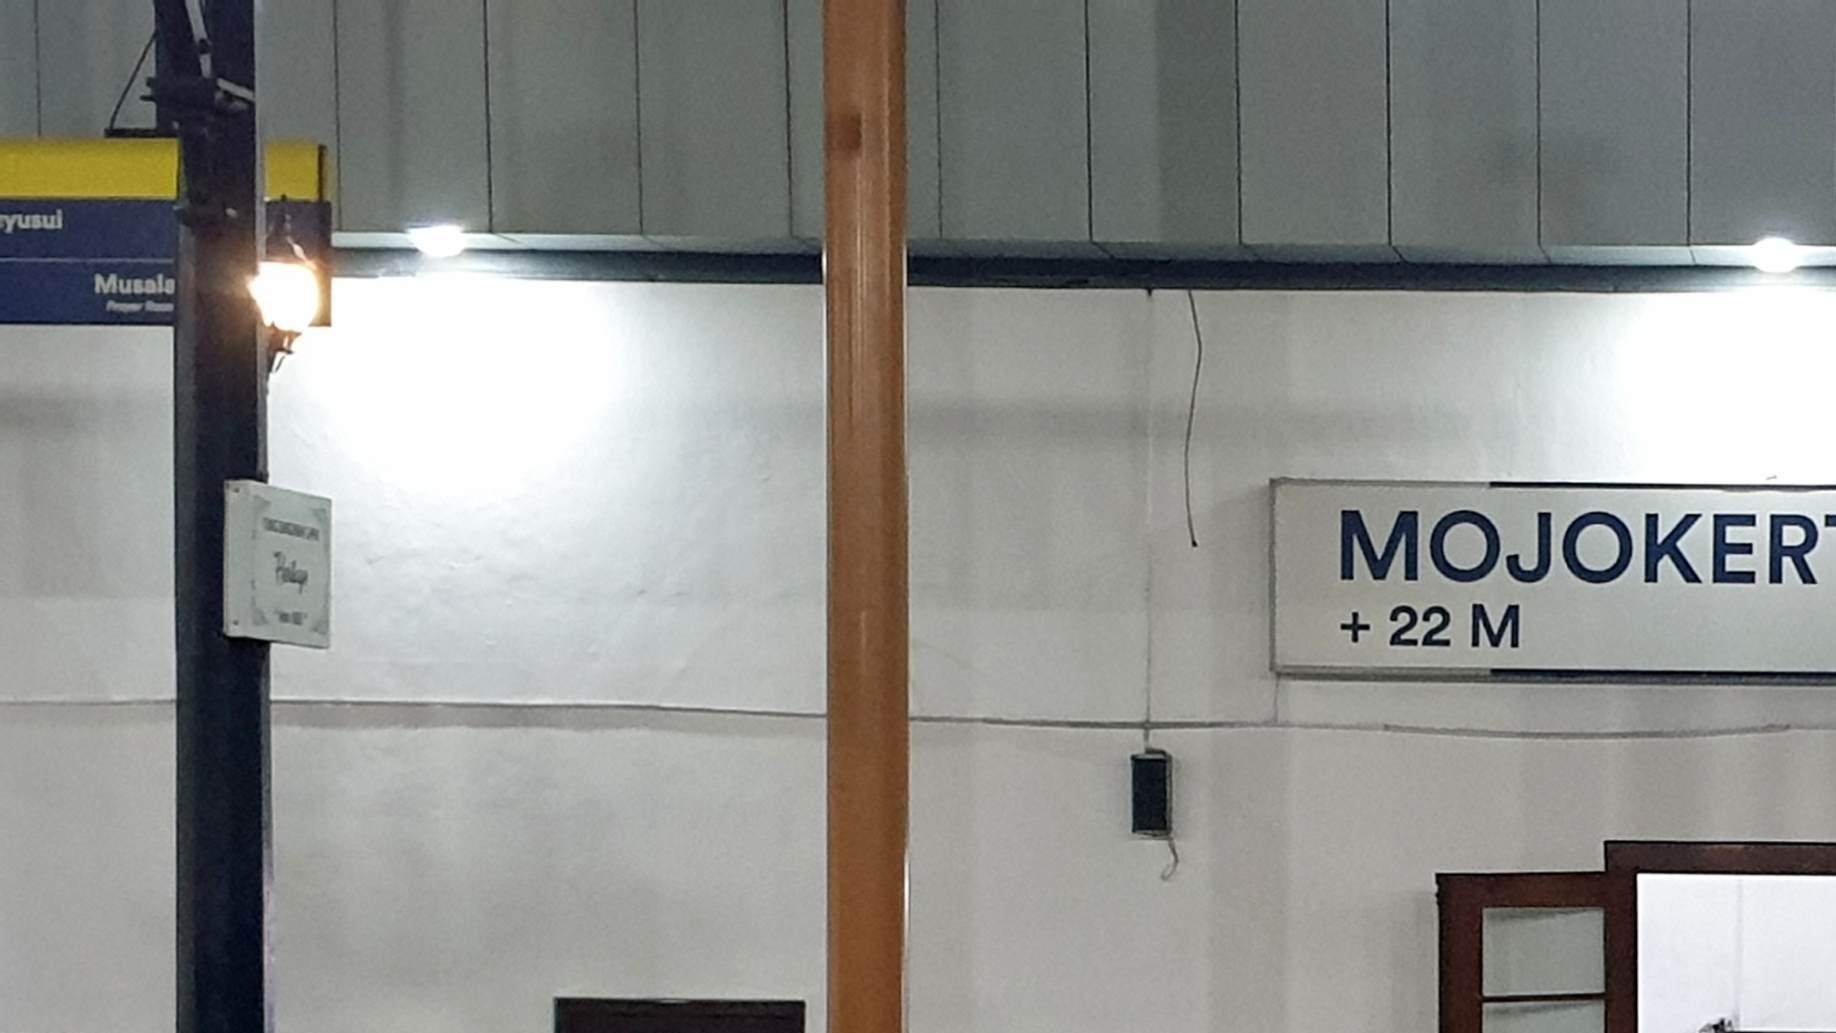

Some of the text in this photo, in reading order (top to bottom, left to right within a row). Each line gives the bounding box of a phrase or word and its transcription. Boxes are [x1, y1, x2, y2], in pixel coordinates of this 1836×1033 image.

[94, 273, 175, 295] Musala
[1389, 604, 1451, 647] 22
[1471, 603, 1520, 649] M
